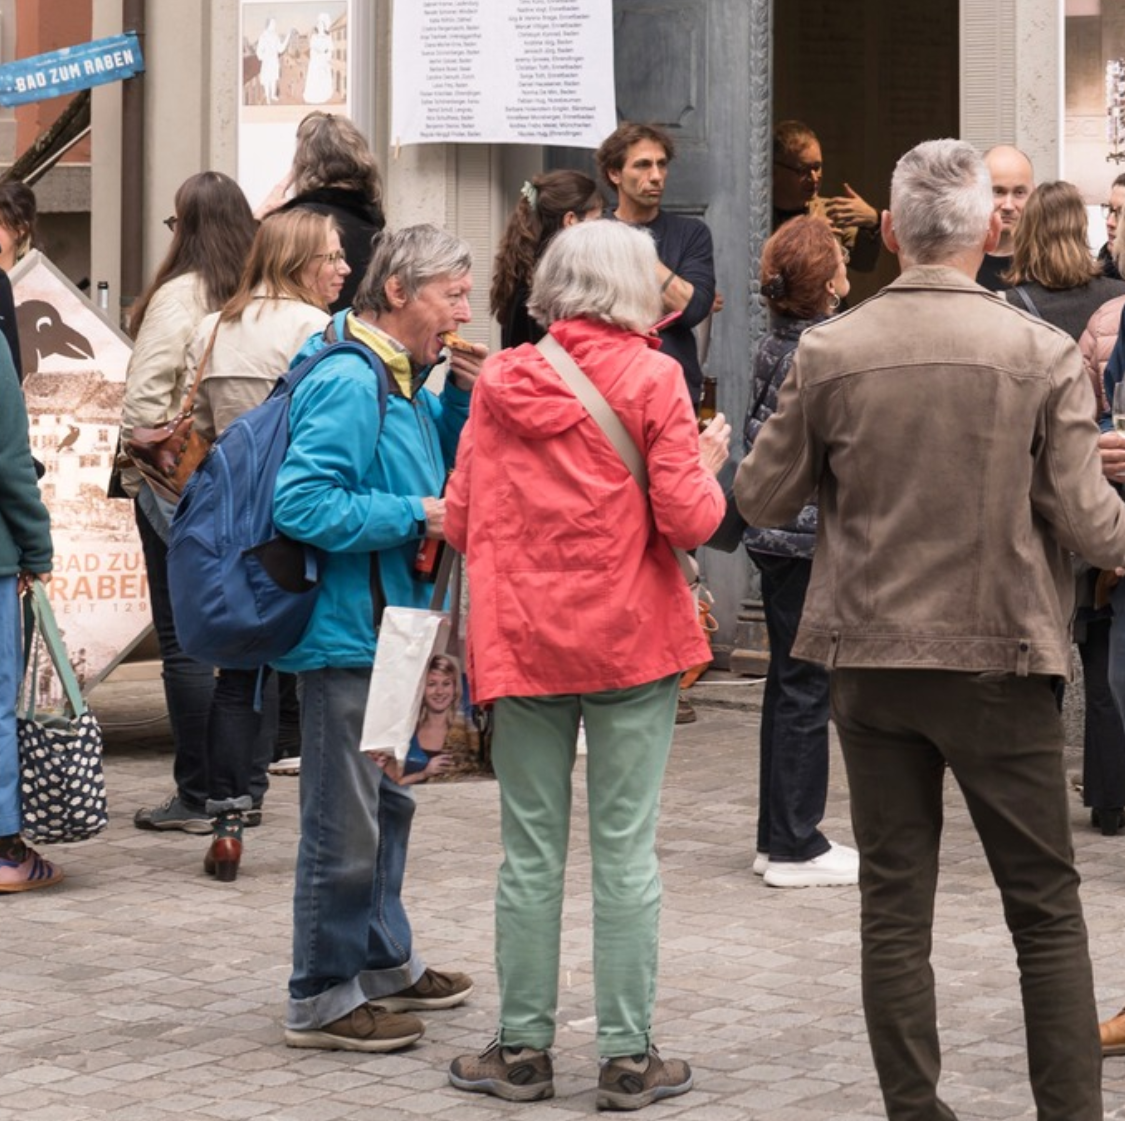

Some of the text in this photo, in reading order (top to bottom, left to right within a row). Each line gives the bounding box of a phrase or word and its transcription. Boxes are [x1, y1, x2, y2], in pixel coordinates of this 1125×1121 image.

[16, 72, 46, 93] BAD
[48, 63, 82, 85] ZUM
[83, 49, 134, 75] RABEN
[53, 553, 147, 573] BAD ZU
[52, 602, 147, 614] EIT 129
